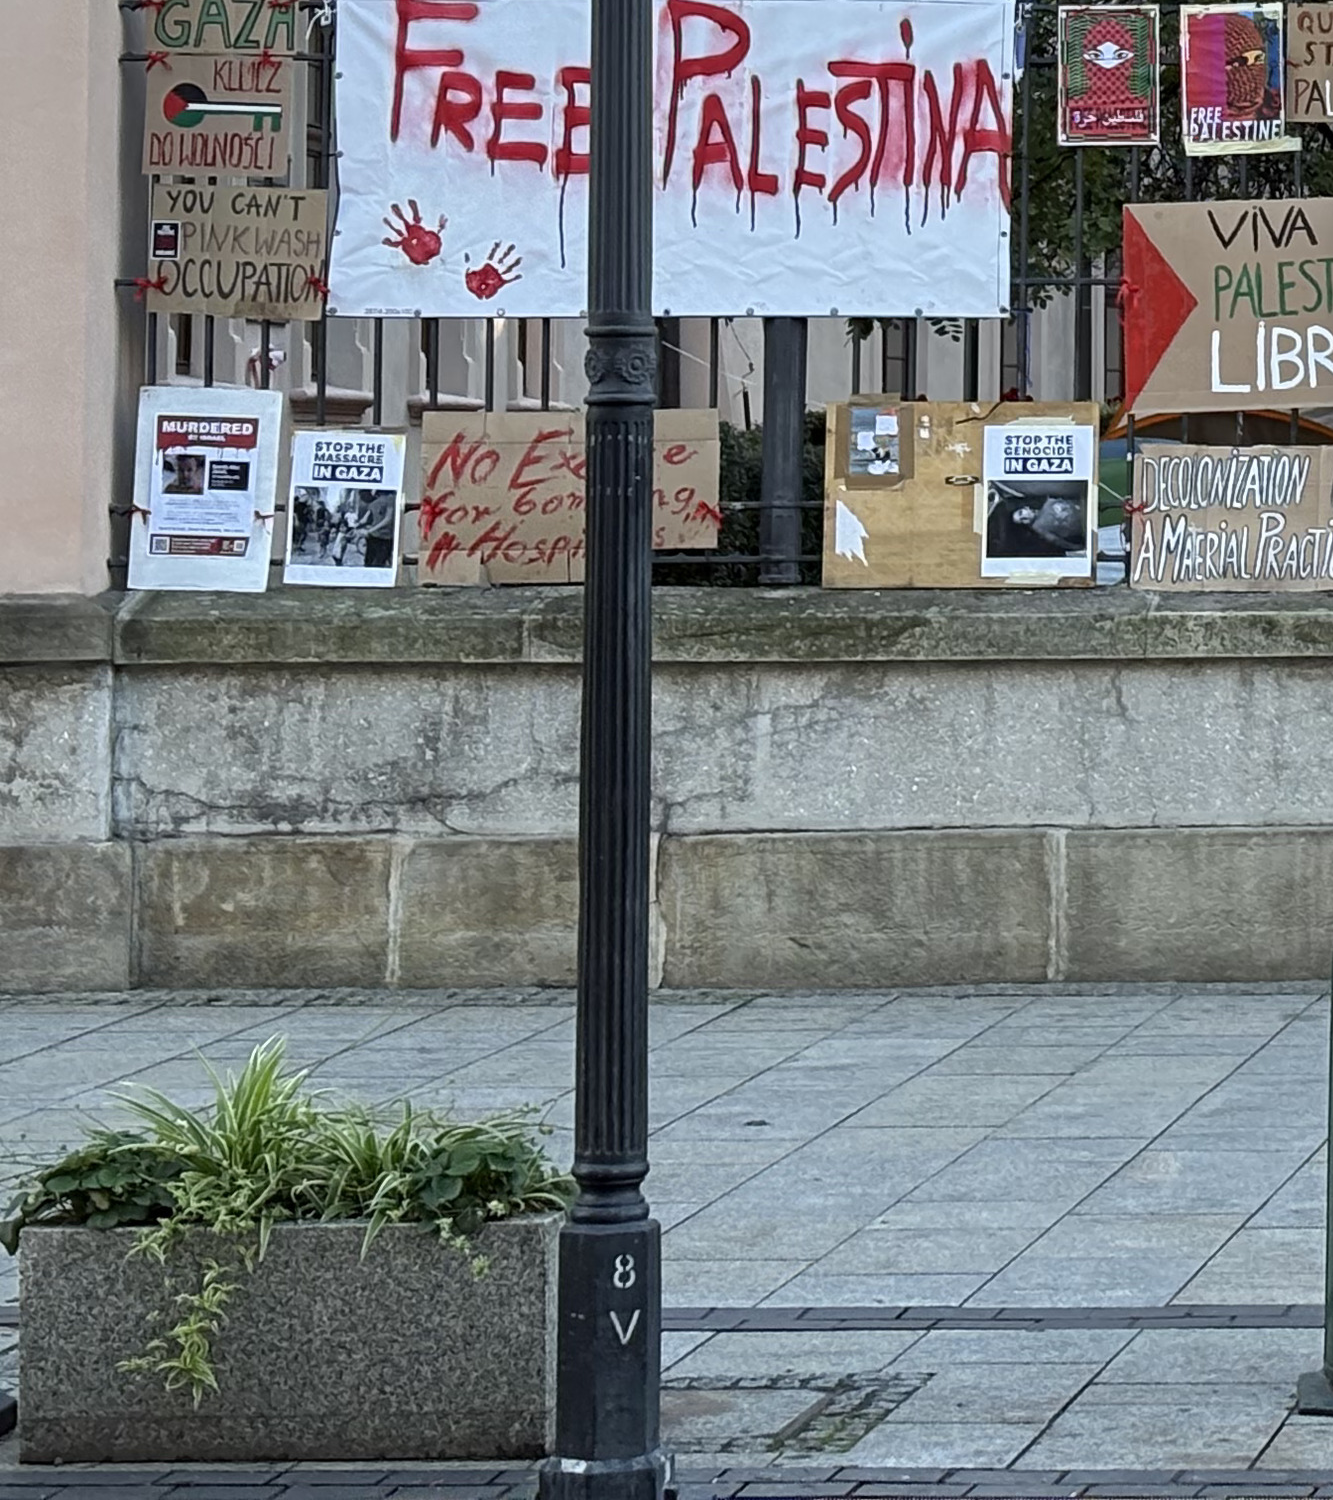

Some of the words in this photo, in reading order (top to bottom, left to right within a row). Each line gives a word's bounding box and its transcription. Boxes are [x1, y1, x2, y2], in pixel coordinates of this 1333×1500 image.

[213, 59, 282, 93] KLUCZ
[1191, 106, 1222, 124] FREE
[1189, 120, 1282, 143] PALESTINE
[149, 132, 174, 166] DO
[166, 190, 214, 214] YOU
[231, 192, 306, 221] CAN'T
[1207, 205, 1318, 252] VIVA
[157, 258, 328, 304] OCCUPATION
[162, 421, 253, 435] MURDERED
[315, 441, 353, 453] STOP
[356, 443, 385, 454] THE
[1004, 435, 1042, 445] STOP
[1045, 435, 1073, 445] THE
[1004, 446, 1073, 455] GENOCIDE
[314, 453, 384, 464] MASSACRE
[1005, 459, 1023, 471] IN
[1026, 459, 1072, 471] GAZA
[313, 465, 332, 479] IN
[335, 466, 382, 480] GAZA
[1133, 518, 1156, 583] A
[613, 1254, 636, 1289] 8
[610, 1309, 641, 1345] V
